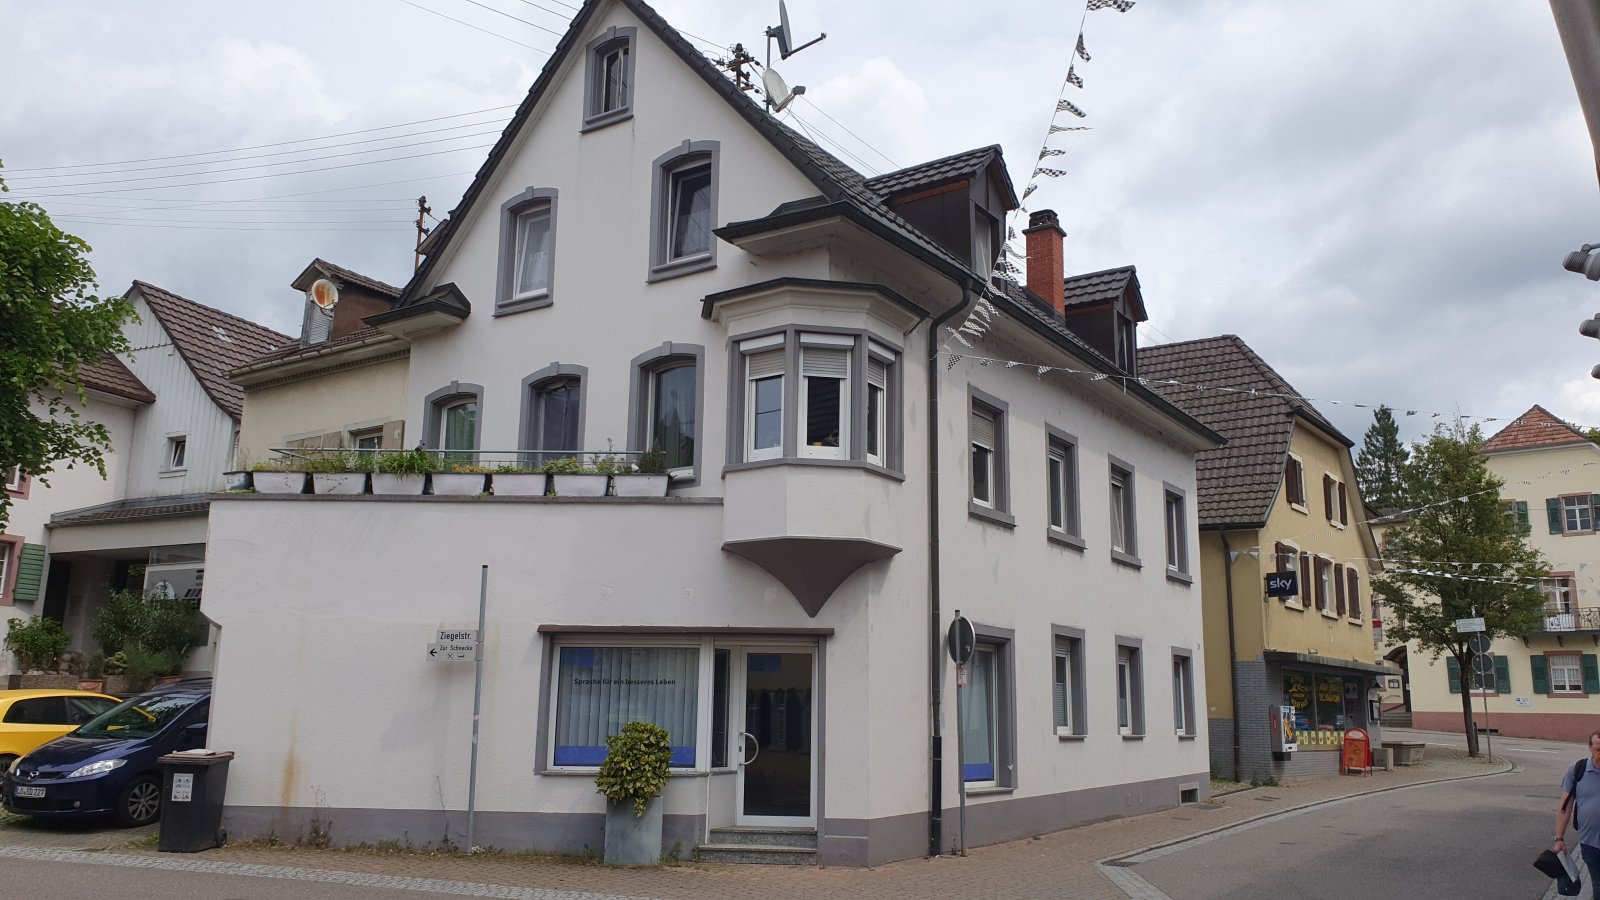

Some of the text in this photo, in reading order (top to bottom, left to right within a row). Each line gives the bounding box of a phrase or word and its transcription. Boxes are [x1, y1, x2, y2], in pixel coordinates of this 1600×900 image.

[1269, 577, 1292, 590] sky
[440, 631, 472, 641] Ziegelstr.
[574, 678, 602, 686] Sprache
